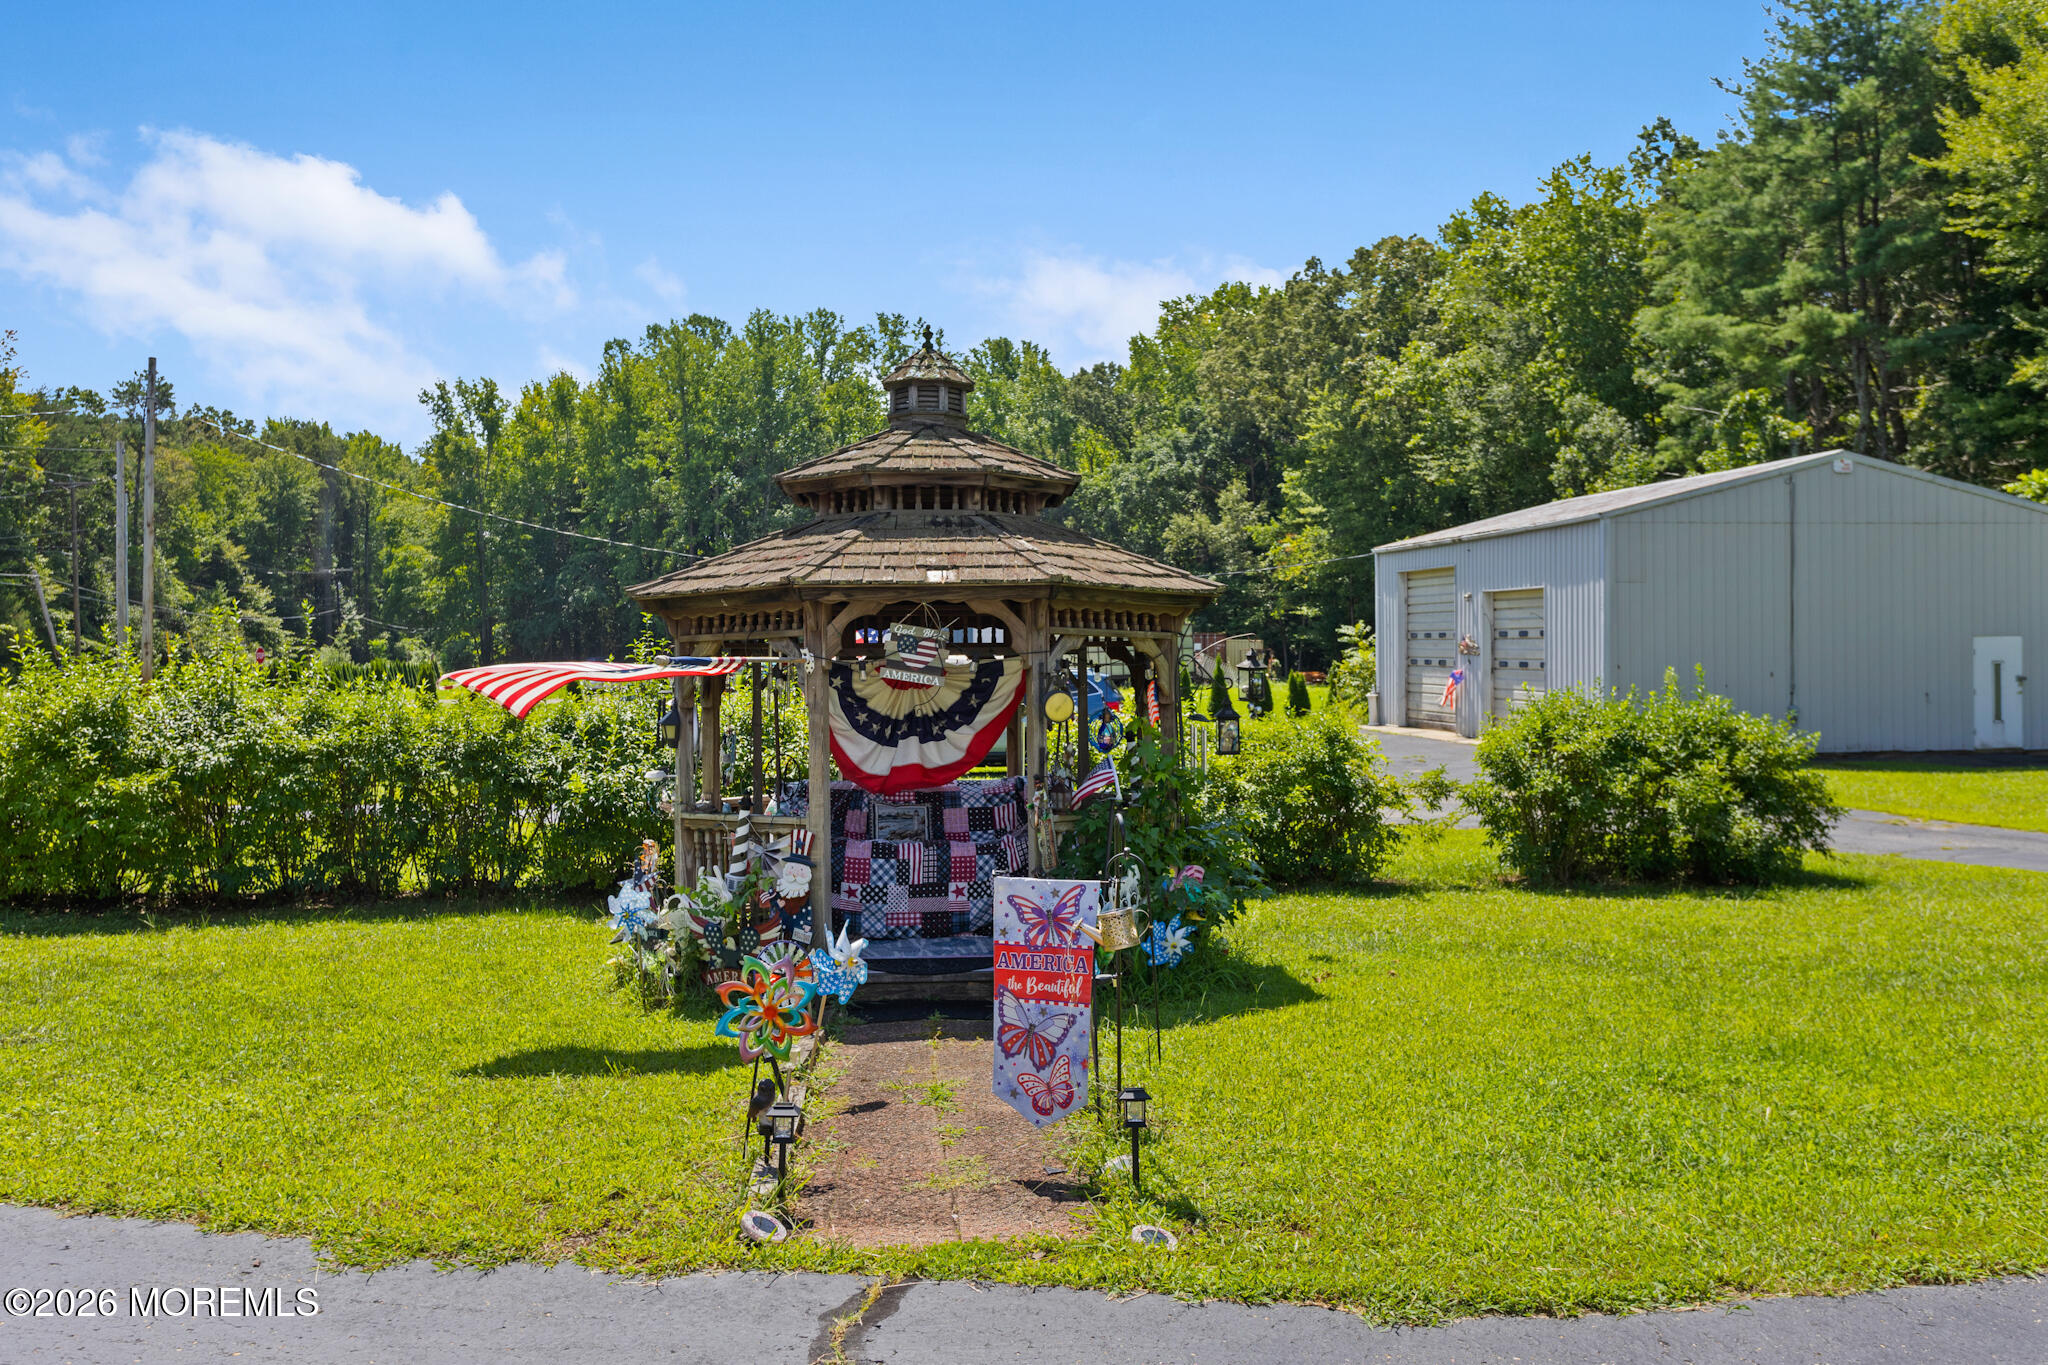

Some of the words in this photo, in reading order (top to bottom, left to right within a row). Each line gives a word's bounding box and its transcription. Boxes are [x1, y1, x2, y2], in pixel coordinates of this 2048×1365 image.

[895, 625, 915, 636] God
[883, 670, 940, 686] AMERICA
[996, 951, 1089, 975] AMERICA
[706, 968, 752, 986] AMER
[1007, 975, 1023, 991] the
[1026, 975, 1083, 998] Beautiful
